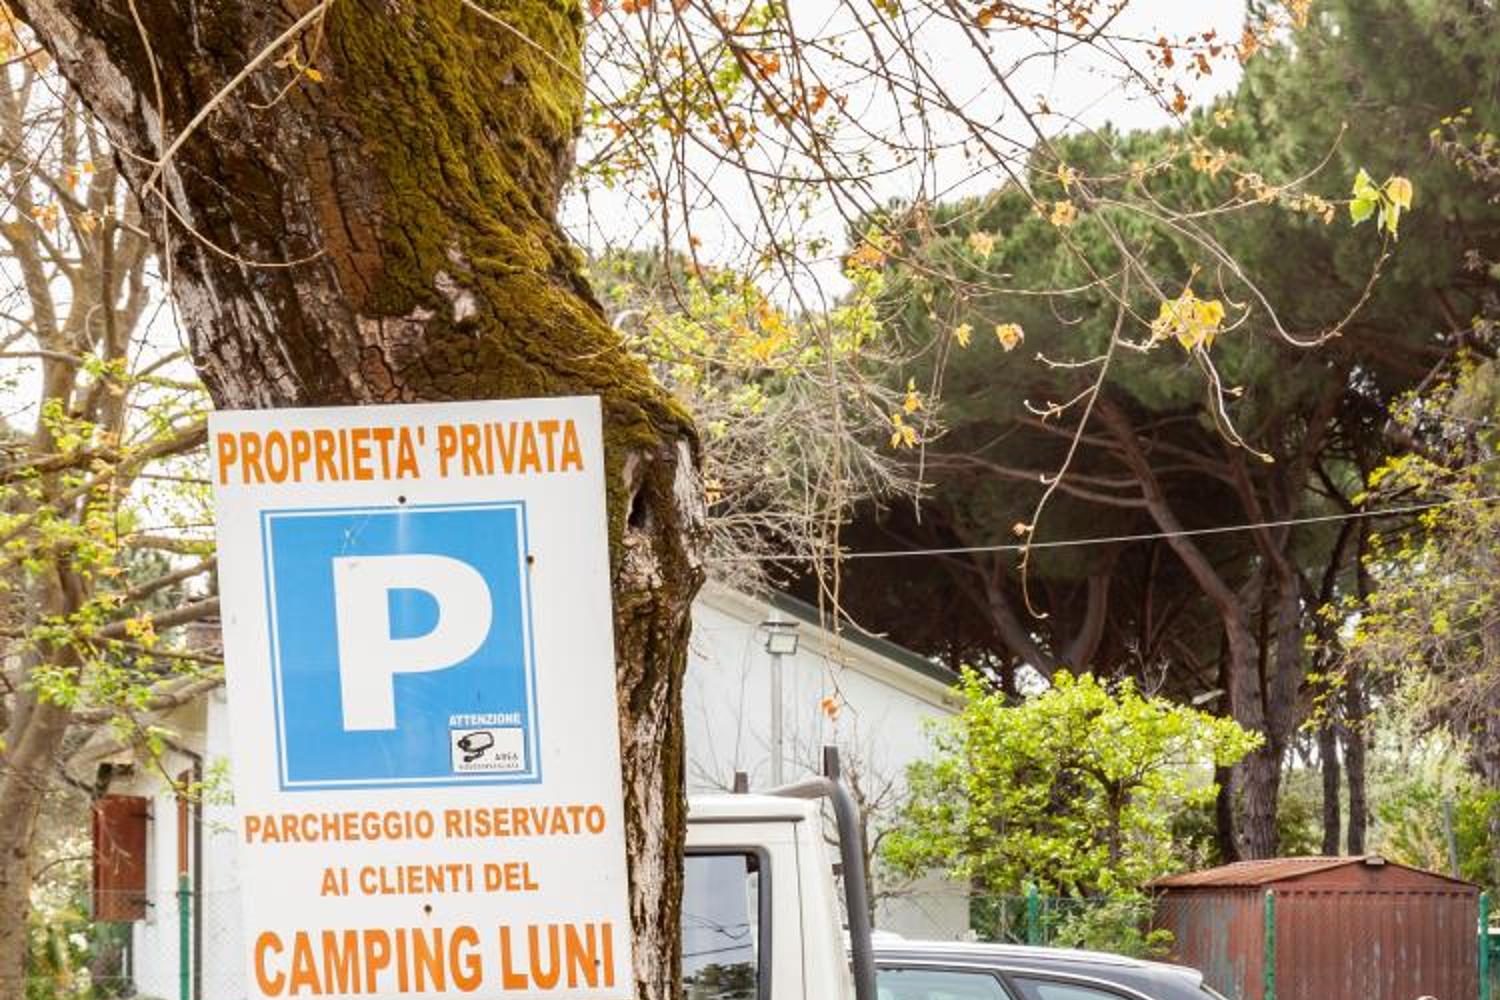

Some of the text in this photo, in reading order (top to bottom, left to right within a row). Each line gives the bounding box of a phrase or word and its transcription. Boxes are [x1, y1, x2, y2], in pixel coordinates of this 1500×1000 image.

[216, 418, 584, 487] PROPRIETA' PRIVATA
[332, 554, 493, 731] P
[449, 712, 521, 727] ATTENZIONE
[244, 804, 607, 844] PARCHEGGIO RISERVATO
[320, 861, 539, 897] AI CLIENTI DEL
[253, 922, 616, 997] CAMPING LUNI
